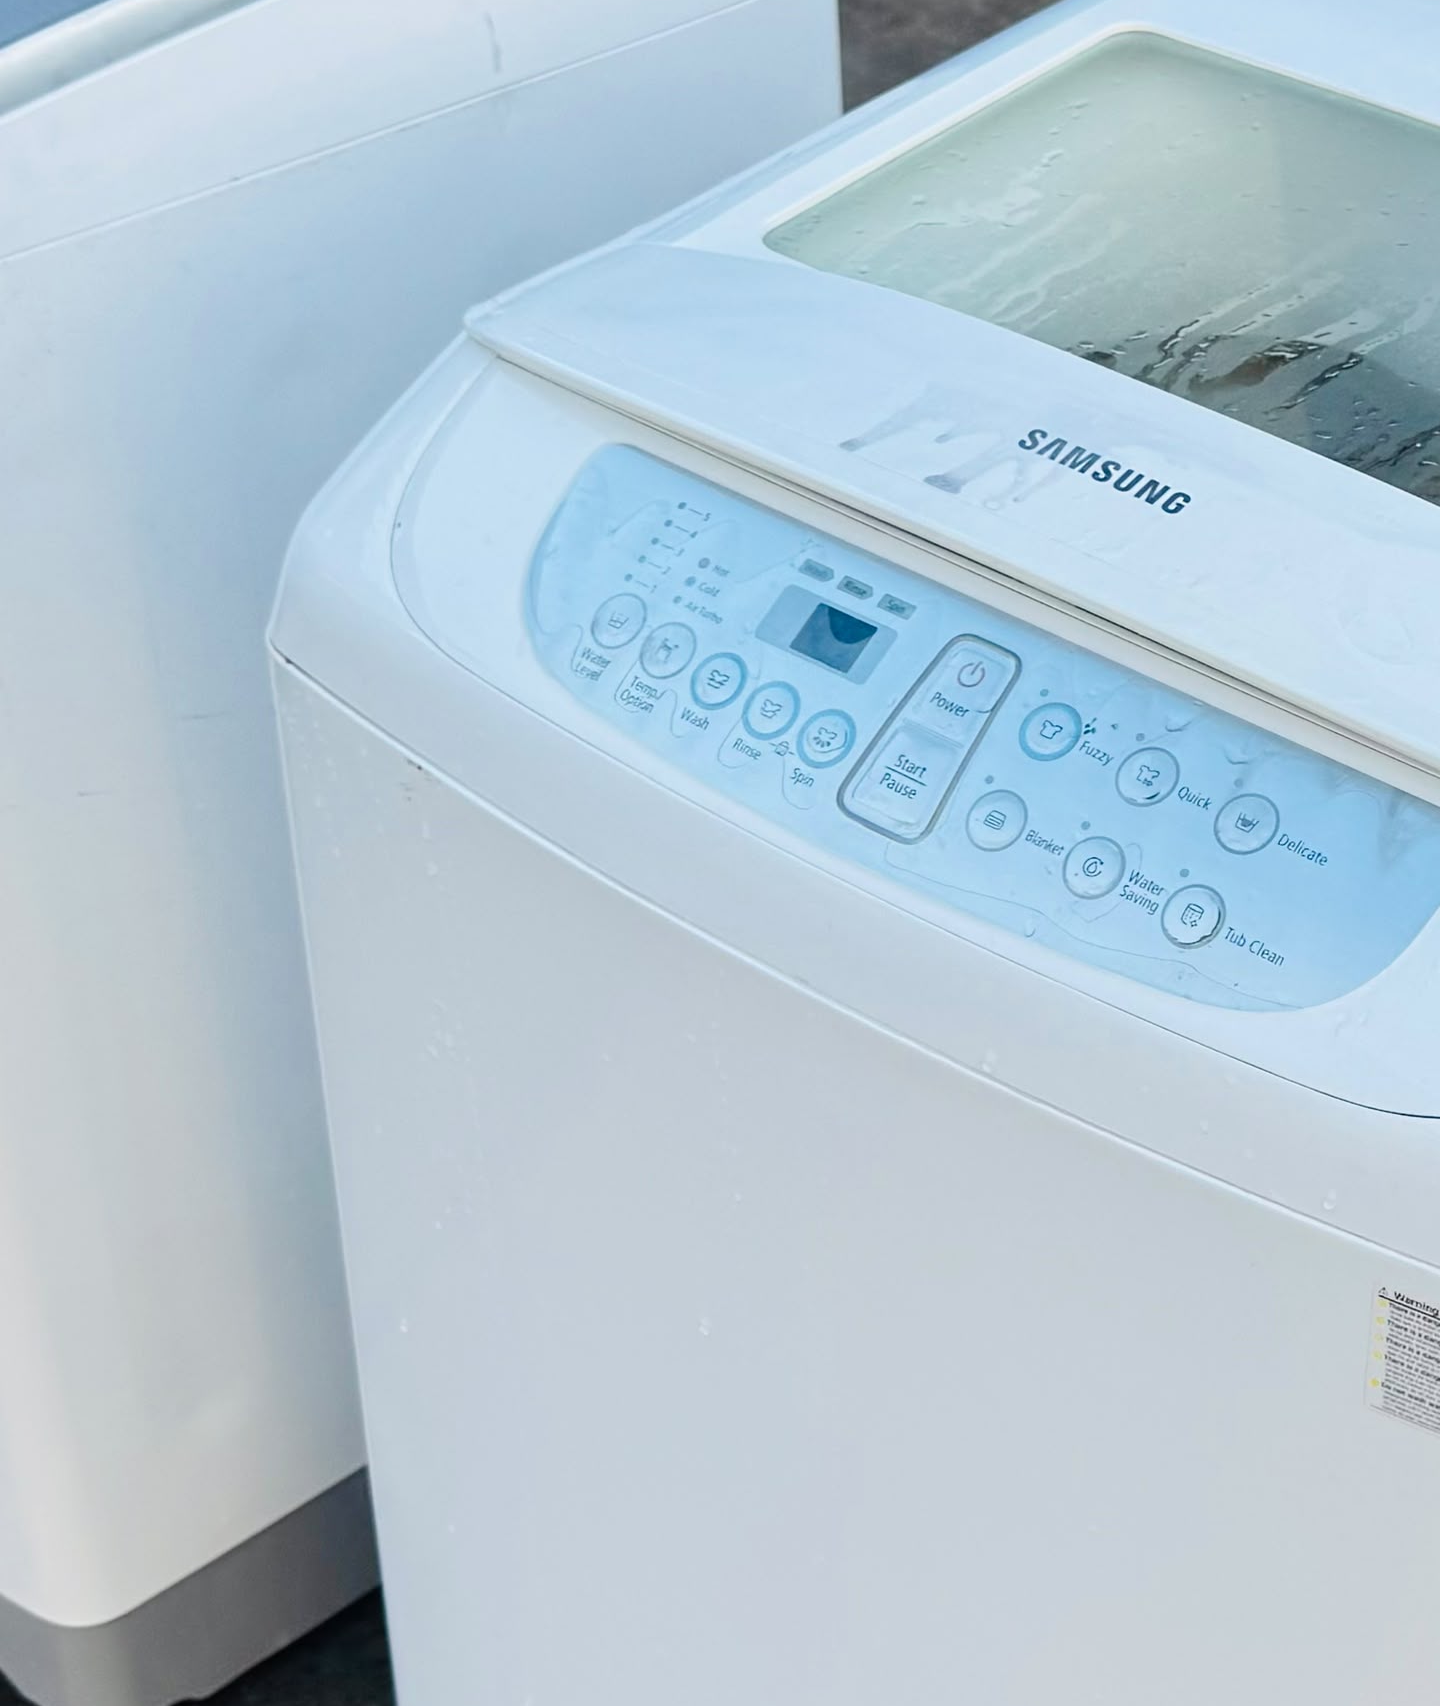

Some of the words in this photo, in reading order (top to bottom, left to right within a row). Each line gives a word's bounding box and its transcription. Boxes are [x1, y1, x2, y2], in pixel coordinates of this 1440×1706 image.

[1018, 429, 1191, 514] SAMSUNG
[580, 647, 611, 670] Water
[575, 663, 604, 682] Level
[619, 688, 654, 713] Option
[928, 691, 970, 718] Power
[680, 706, 710, 731] Wash
[731, 737, 762, 761] Rinse
[1078, 740, 1114, 767] Fuzzy
[790, 767, 815, 788] Spin
[893, 753, 928, 778] Start
[879, 773, 917, 800] Pause
[1177, 786, 1212, 811] Quick
[1025, 829, 1064, 856] Blanket
[1277, 833, 1328, 867] Delicate
[1128, 869, 1165, 896] Water
[1119, 884, 1160, 916] Saving
[1224, 926, 1246, 948] Tub
[1249, 940, 1285, 967] Clean
[1393, 1291, 1440, 1317] Warning
